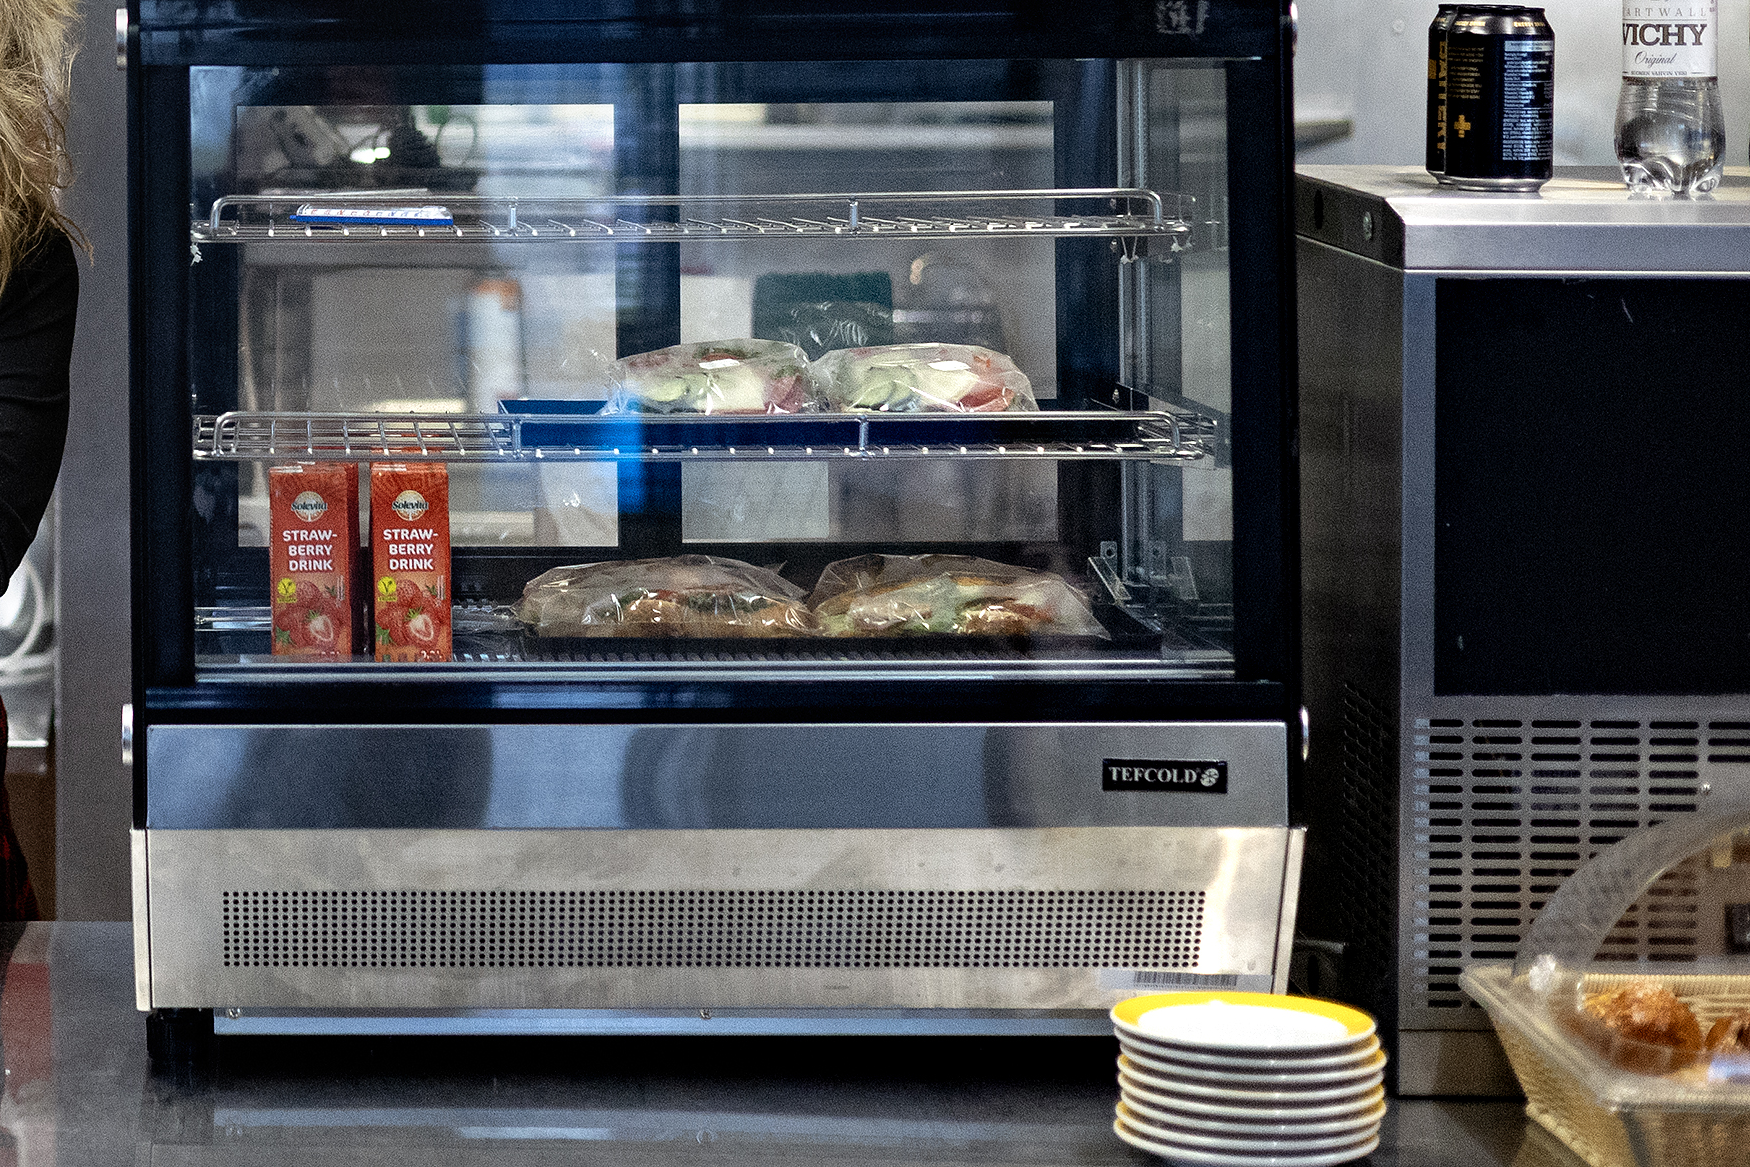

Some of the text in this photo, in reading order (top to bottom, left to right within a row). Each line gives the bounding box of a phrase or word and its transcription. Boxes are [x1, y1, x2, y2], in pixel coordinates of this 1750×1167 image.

[1623, 7, 1707, 17] ARTWALL
[1622, 22, 1708, 46] VICHY
[1634, 51, 1678, 68] Original
[282, 529, 338, 542] STRAW-
[383, 528, 439, 541] STRAW-
[288, 544, 333, 556] BERRY
[389, 543, 434, 555] BERRY
[289, 559, 333, 572] DRINK
[389, 558, 434, 571] DRINK
[1108, 766, 1198, 783] TEFCOLD
